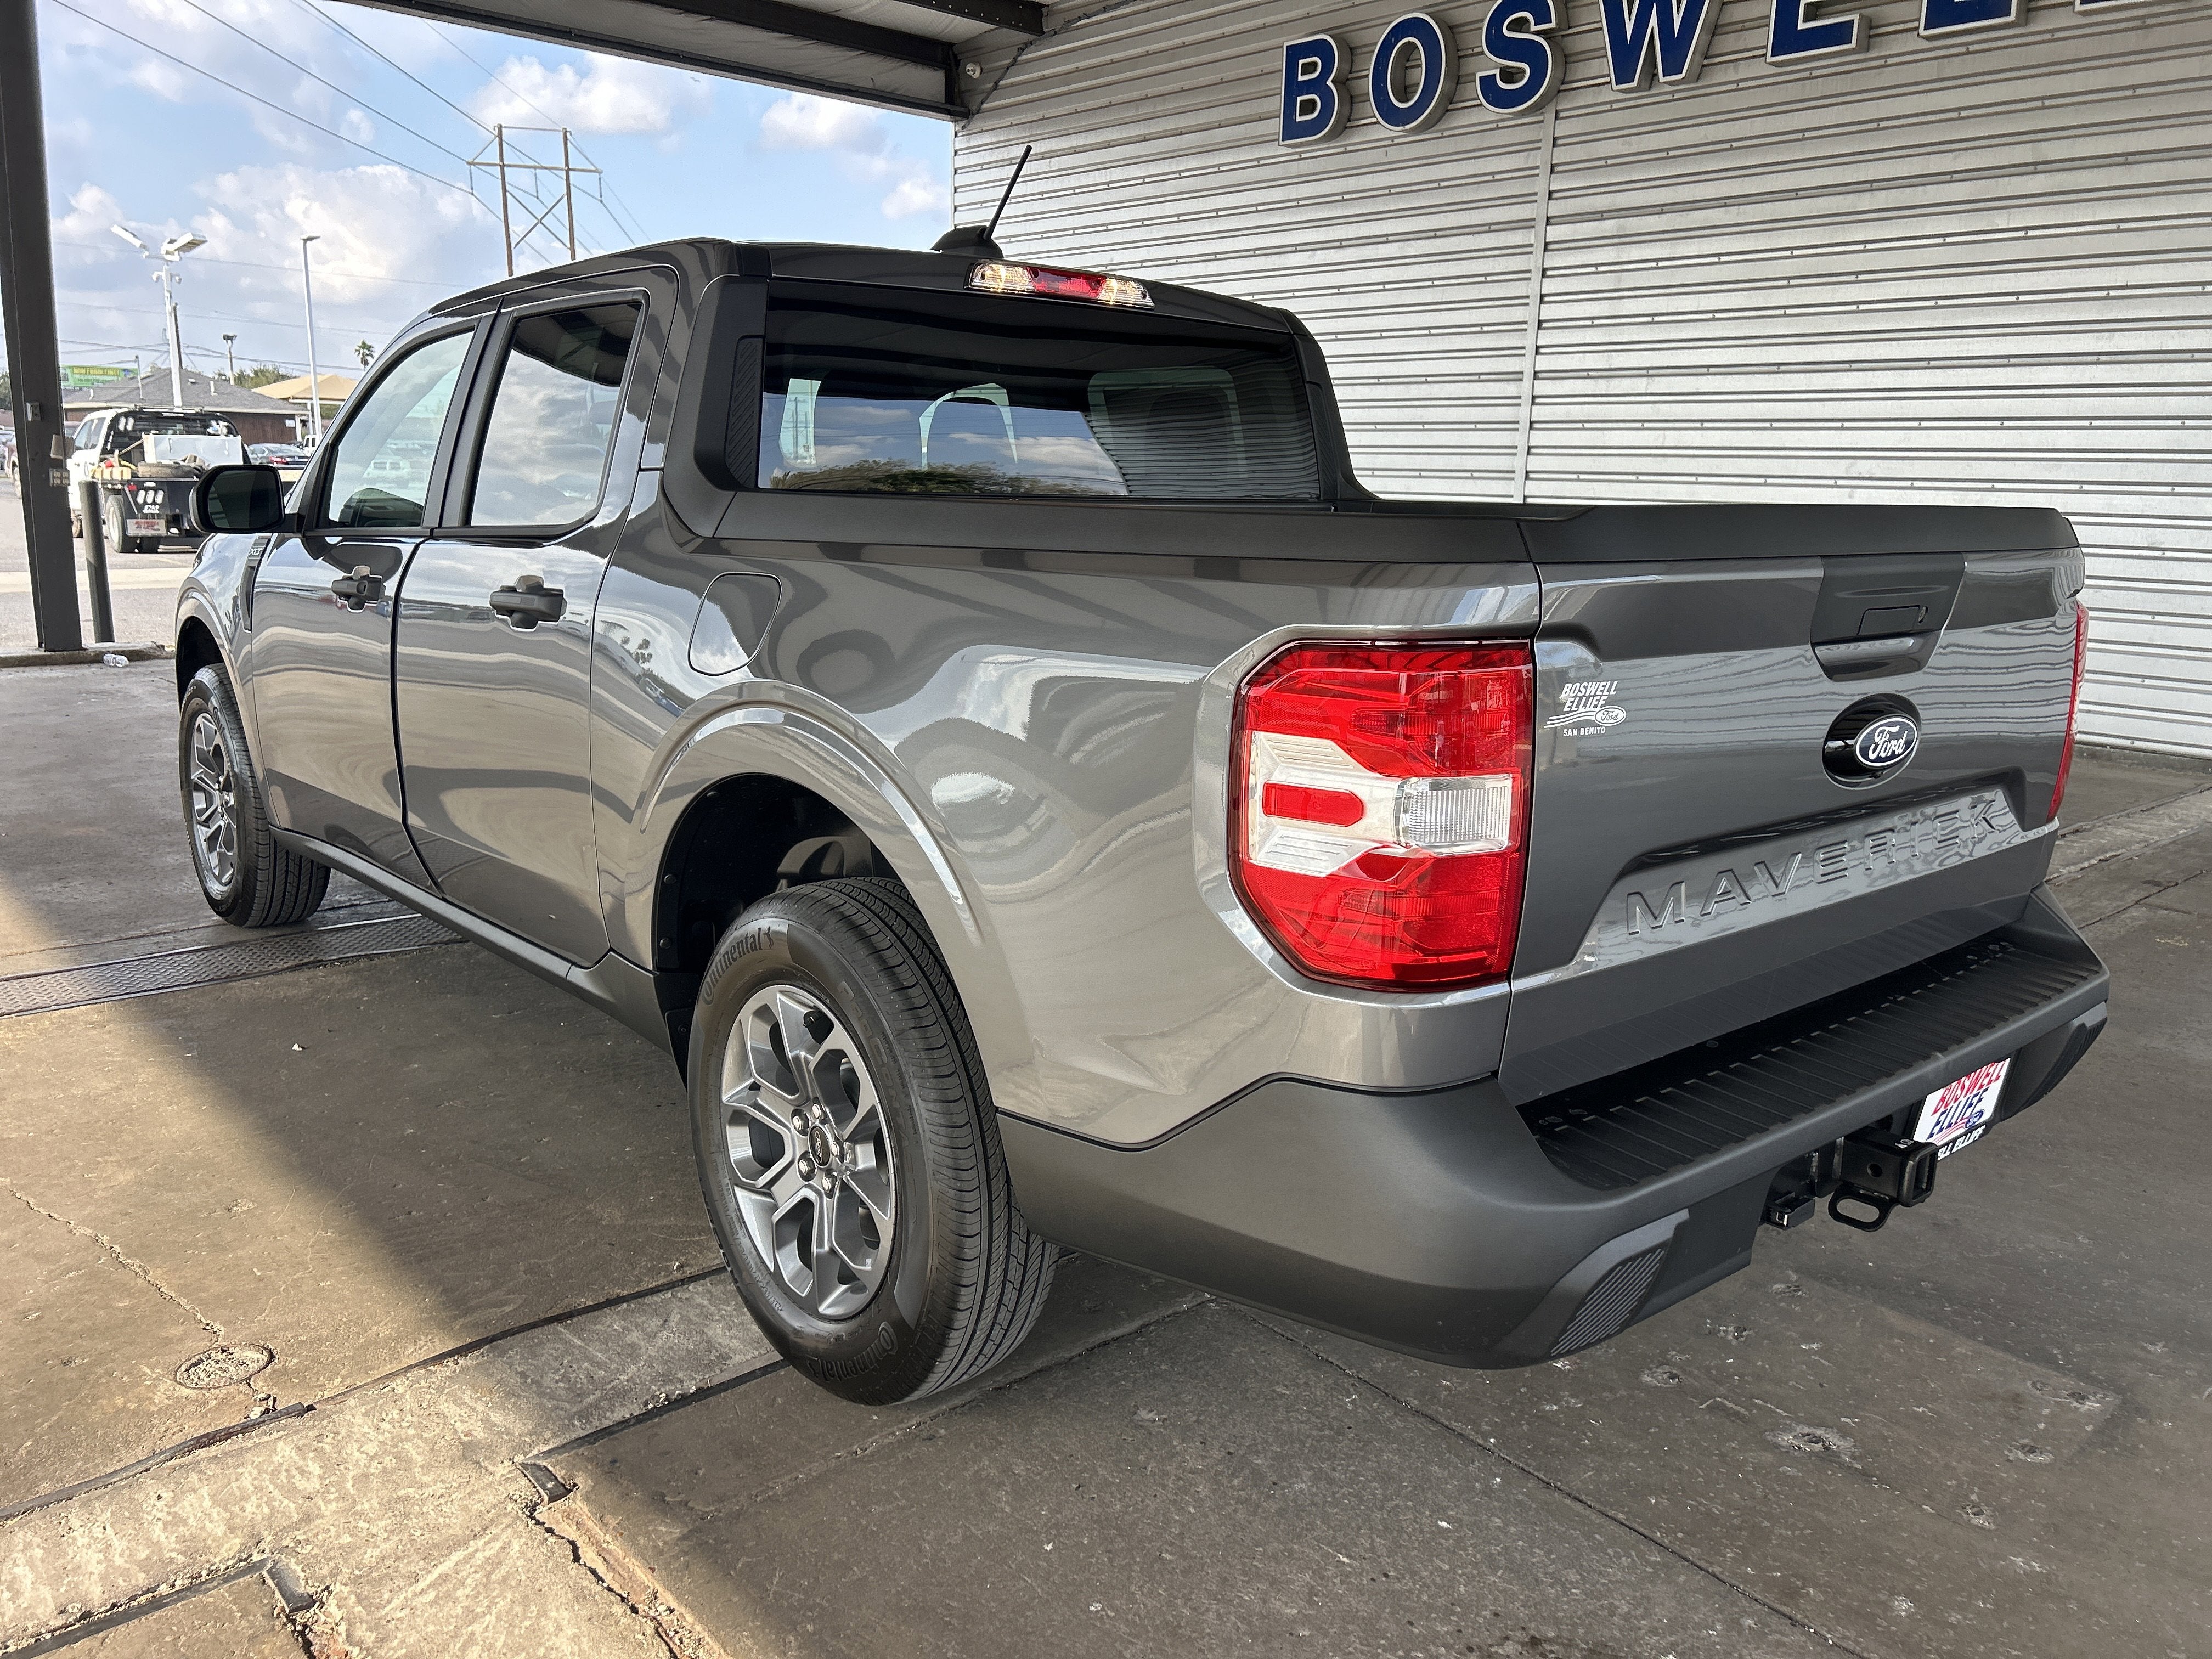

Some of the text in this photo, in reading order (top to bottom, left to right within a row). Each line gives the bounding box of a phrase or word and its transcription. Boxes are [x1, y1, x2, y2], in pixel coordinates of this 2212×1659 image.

[249, 548, 263, 556] XLT
[1561, 681, 1618, 697] BOSWELL
[1564, 726, 1606, 736] SAN BENITO
[1869, 725, 1908, 760] Ford
[1627, 800, 1996, 935] MAVERICK
[702, 927, 763, 1005] Continental
[1931, 1061, 2005, 1116] BOSWELL
[1926, 1086, 1990, 1141] ELLIFF
[1951, 1125, 1986, 1153] ELLIFF
